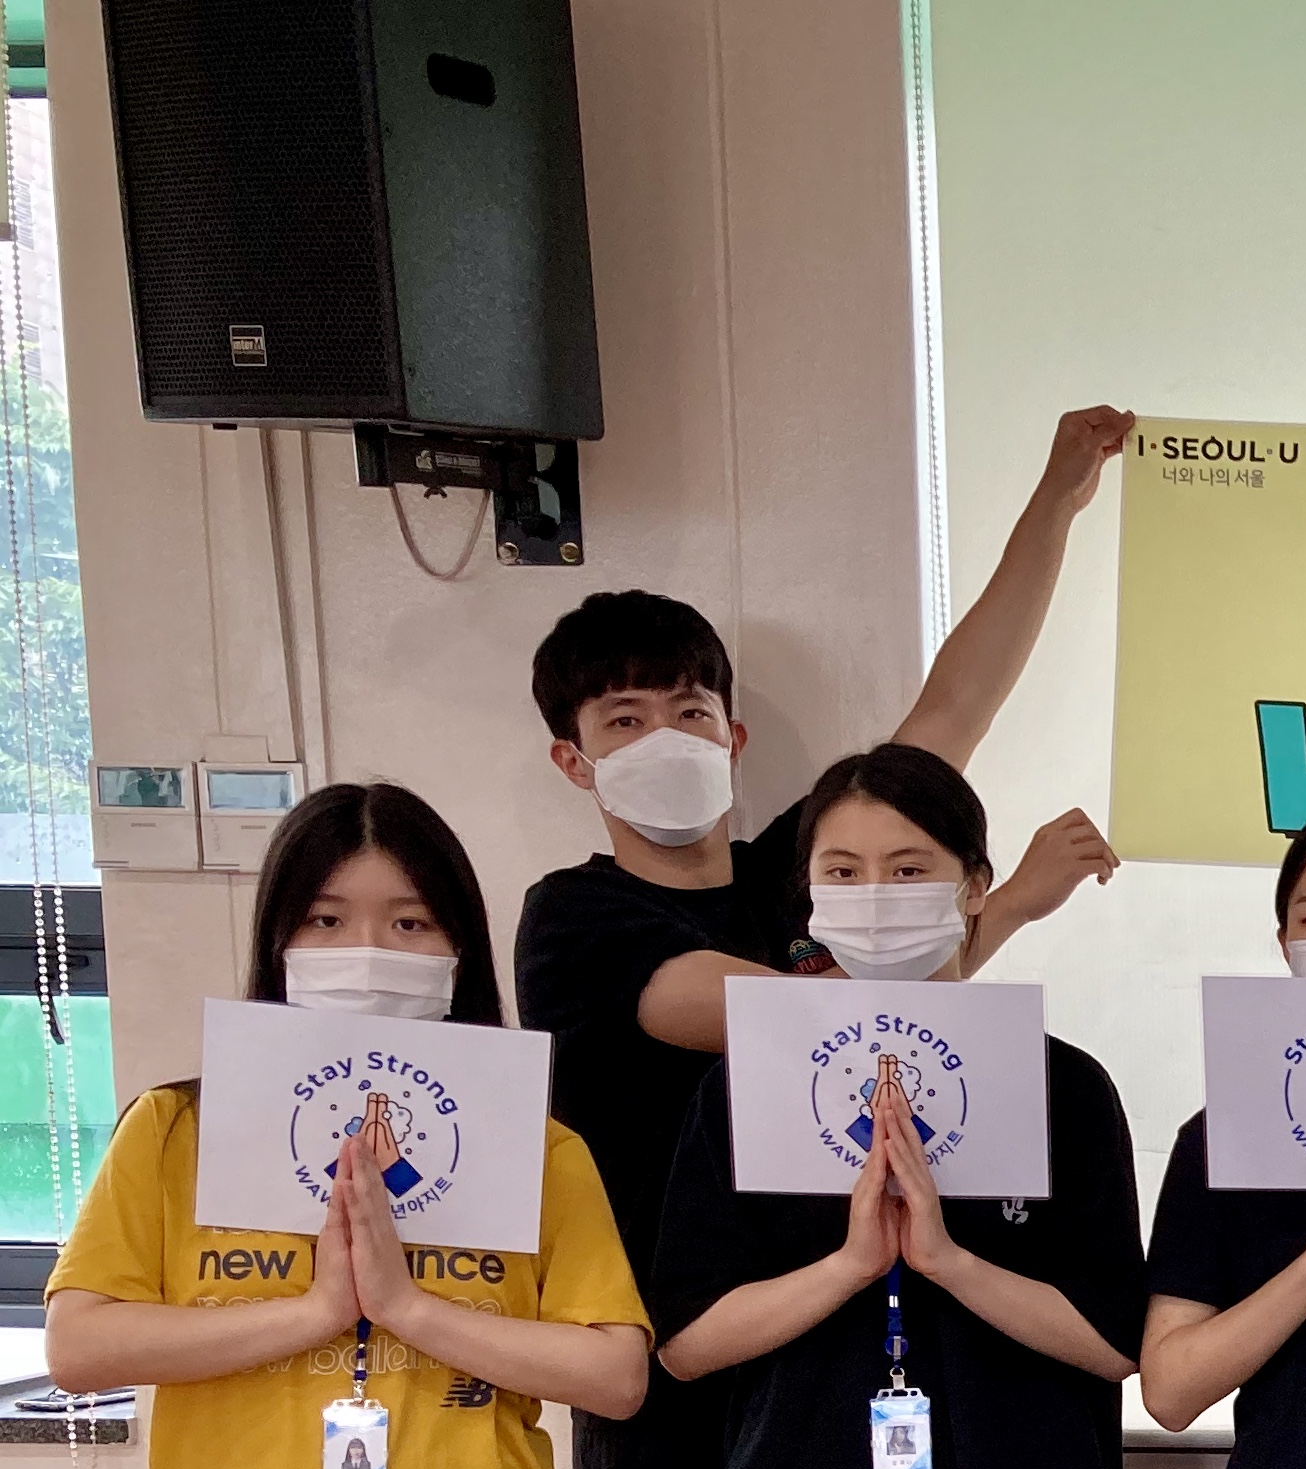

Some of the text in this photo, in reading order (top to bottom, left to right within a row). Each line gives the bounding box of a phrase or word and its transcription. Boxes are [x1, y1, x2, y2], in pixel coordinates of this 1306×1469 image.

[1162, 466, 1265, 488] 너와 나의 서울
[811, 1014, 963, 1072] Stay Strong
[294, 1051, 458, 1116] Stay Strong
[198, 1249, 297, 1281] new
